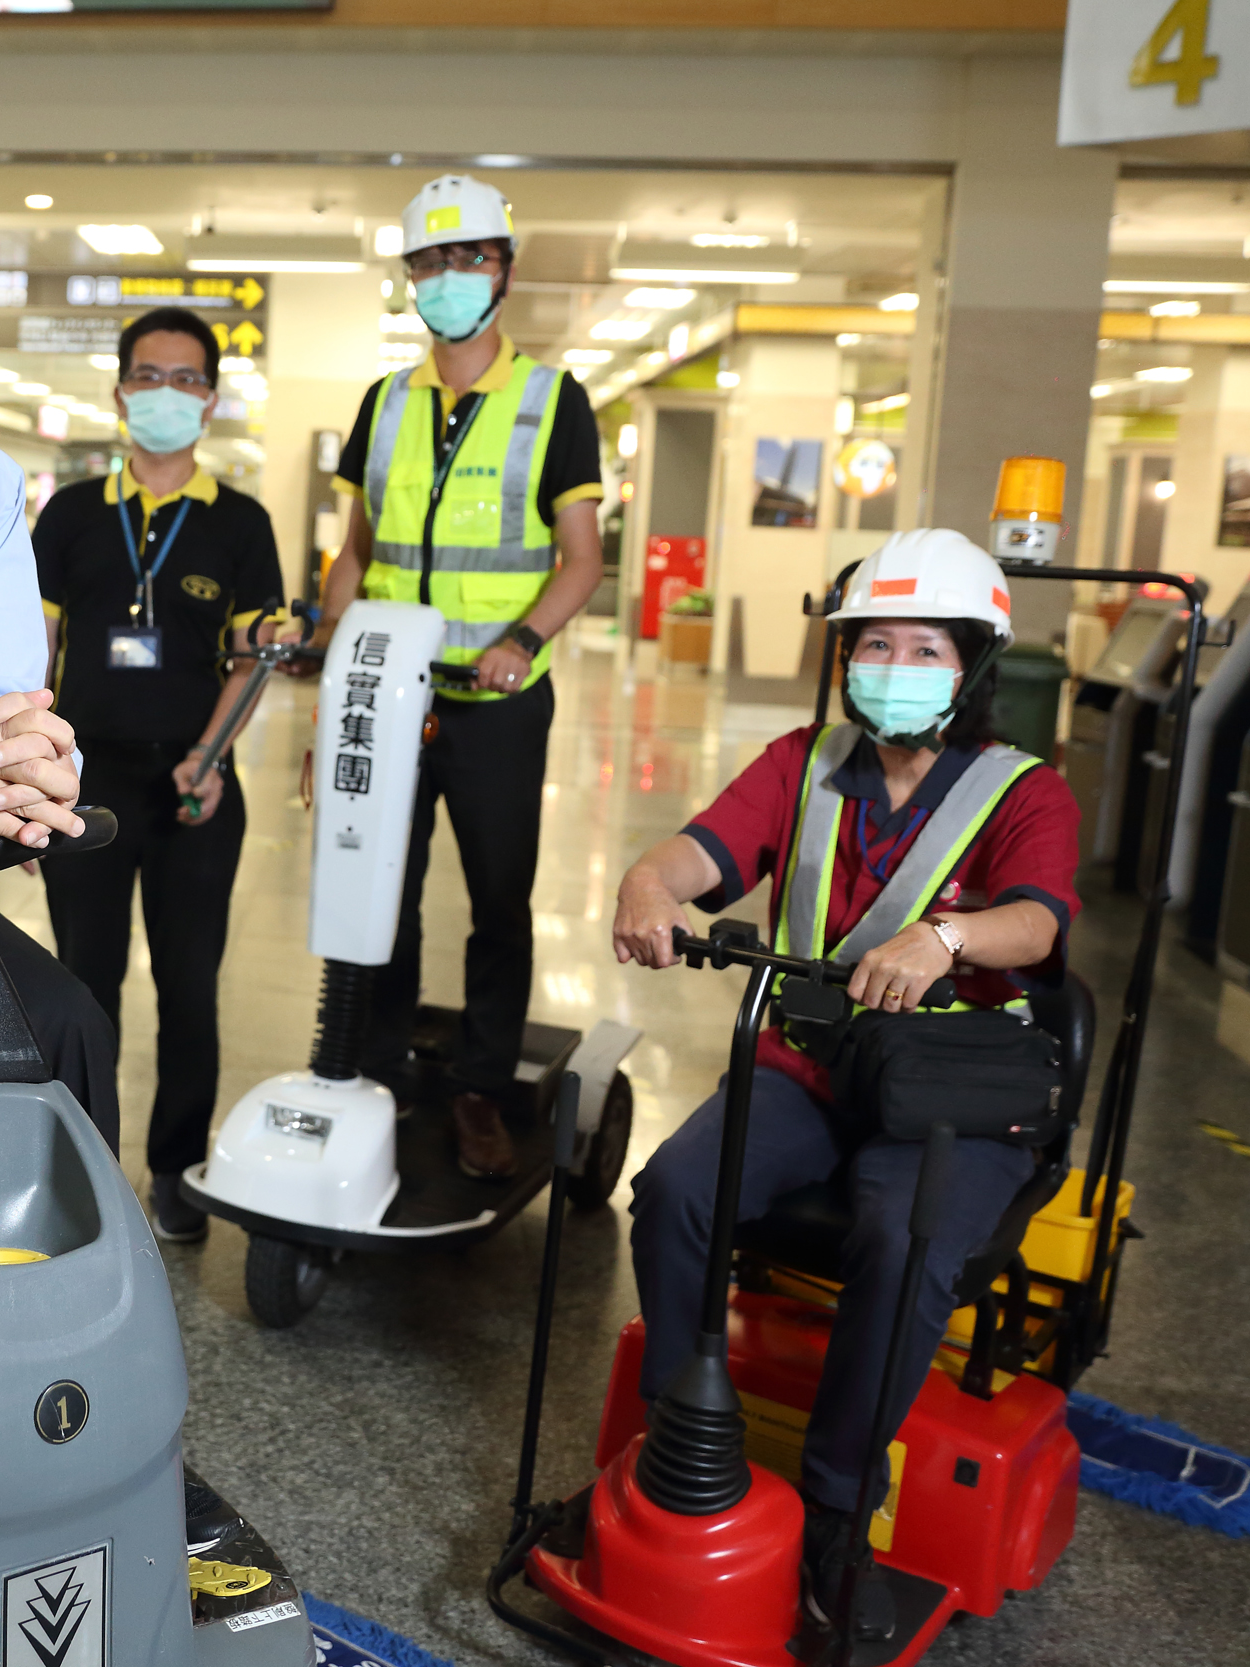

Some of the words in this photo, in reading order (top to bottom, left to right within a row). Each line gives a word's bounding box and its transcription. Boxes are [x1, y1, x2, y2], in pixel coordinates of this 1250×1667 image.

[1129, 0, 1220, 106] 4
[334, 630, 391, 795] 信實集團
[56, 1395, 71, 1430] 1
